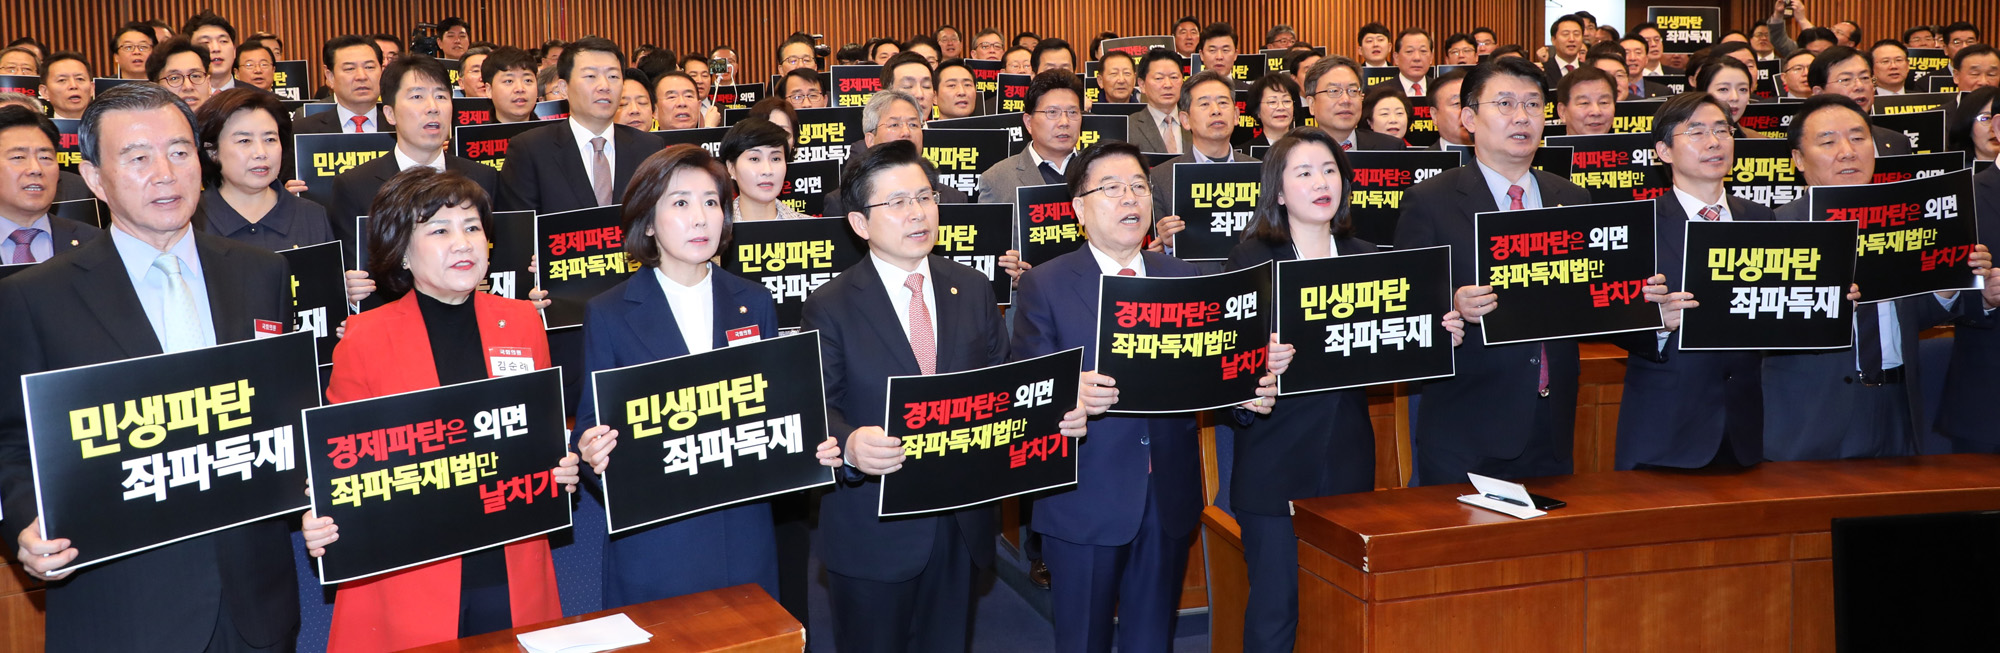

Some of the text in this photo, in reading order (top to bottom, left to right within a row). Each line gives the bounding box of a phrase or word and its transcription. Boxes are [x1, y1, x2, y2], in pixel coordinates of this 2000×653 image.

[1657, 16, 1703, 29] 민생파탄
[1666, 30, 1712, 43] 좌파독재
[839, 78, 883, 92] 경제파탄
[798, 122, 846, 144] 생파탄
[466, 139, 510, 158] 경제파
[922, 147, 979, 170] 생파탄
[1573, 150, 1629, 168] 제파탄은
[794, 176, 822, 194] 외면
[1353, 168, 1411, 187] 제파탄은
[1571, 170, 1645, 189] 파독재법만
[1724, 158, 1796, 182] 생파탄
[1191, 182, 1261, 208] 민생파
[1350, 190, 1403, 208] 파독재
[1924, 194, 1959, 220] 외면
[1029, 202, 1075, 223] 경제파
[548, 226, 626, 256] 경제파탄
[934, 225, 977, 251] 파탄
[1489, 225, 1628, 260] 경제파탄은 외면
[1856, 227, 1939, 257] 독재법만
[549, 252, 642, 281] 좌파독재
[738, 240, 834, 273] 민생파탄
[1708, 247, 1821, 282] 민생파탄
[1921, 244, 1976, 273] 날치기
[1489, 258, 1605, 289] 좌파독재법만
[1300, 277, 1410, 321] 민생파탄
[1589, 278, 1650, 308] 날치기
[1729, 286, 1841, 320] 좌파독재
[1114, 291, 1258, 328] 경제파탄은 외면
[1111, 329, 1238, 359] 좌파독재법만
[1324, 314, 1433, 357] 좌파독재
[1221, 345, 1269, 381] 날치기
[69, 379, 255, 459] 민생파탄
[626, 373, 768, 439] 민생파탄
[902, 378, 1055, 430] 경제파탄은 외면
[327, 403, 529, 470] 경제파탄은 외면
[662, 413, 803, 476] 좌파독재
[901, 418, 1027, 460] 좌파독재법만
[1009, 433, 1068, 469] 날치기
[121, 424, 296, 502] 좌파독재
[330, 452, 499, 507] 좌파독재법만
[479, 469, 559, 514] 날치기
